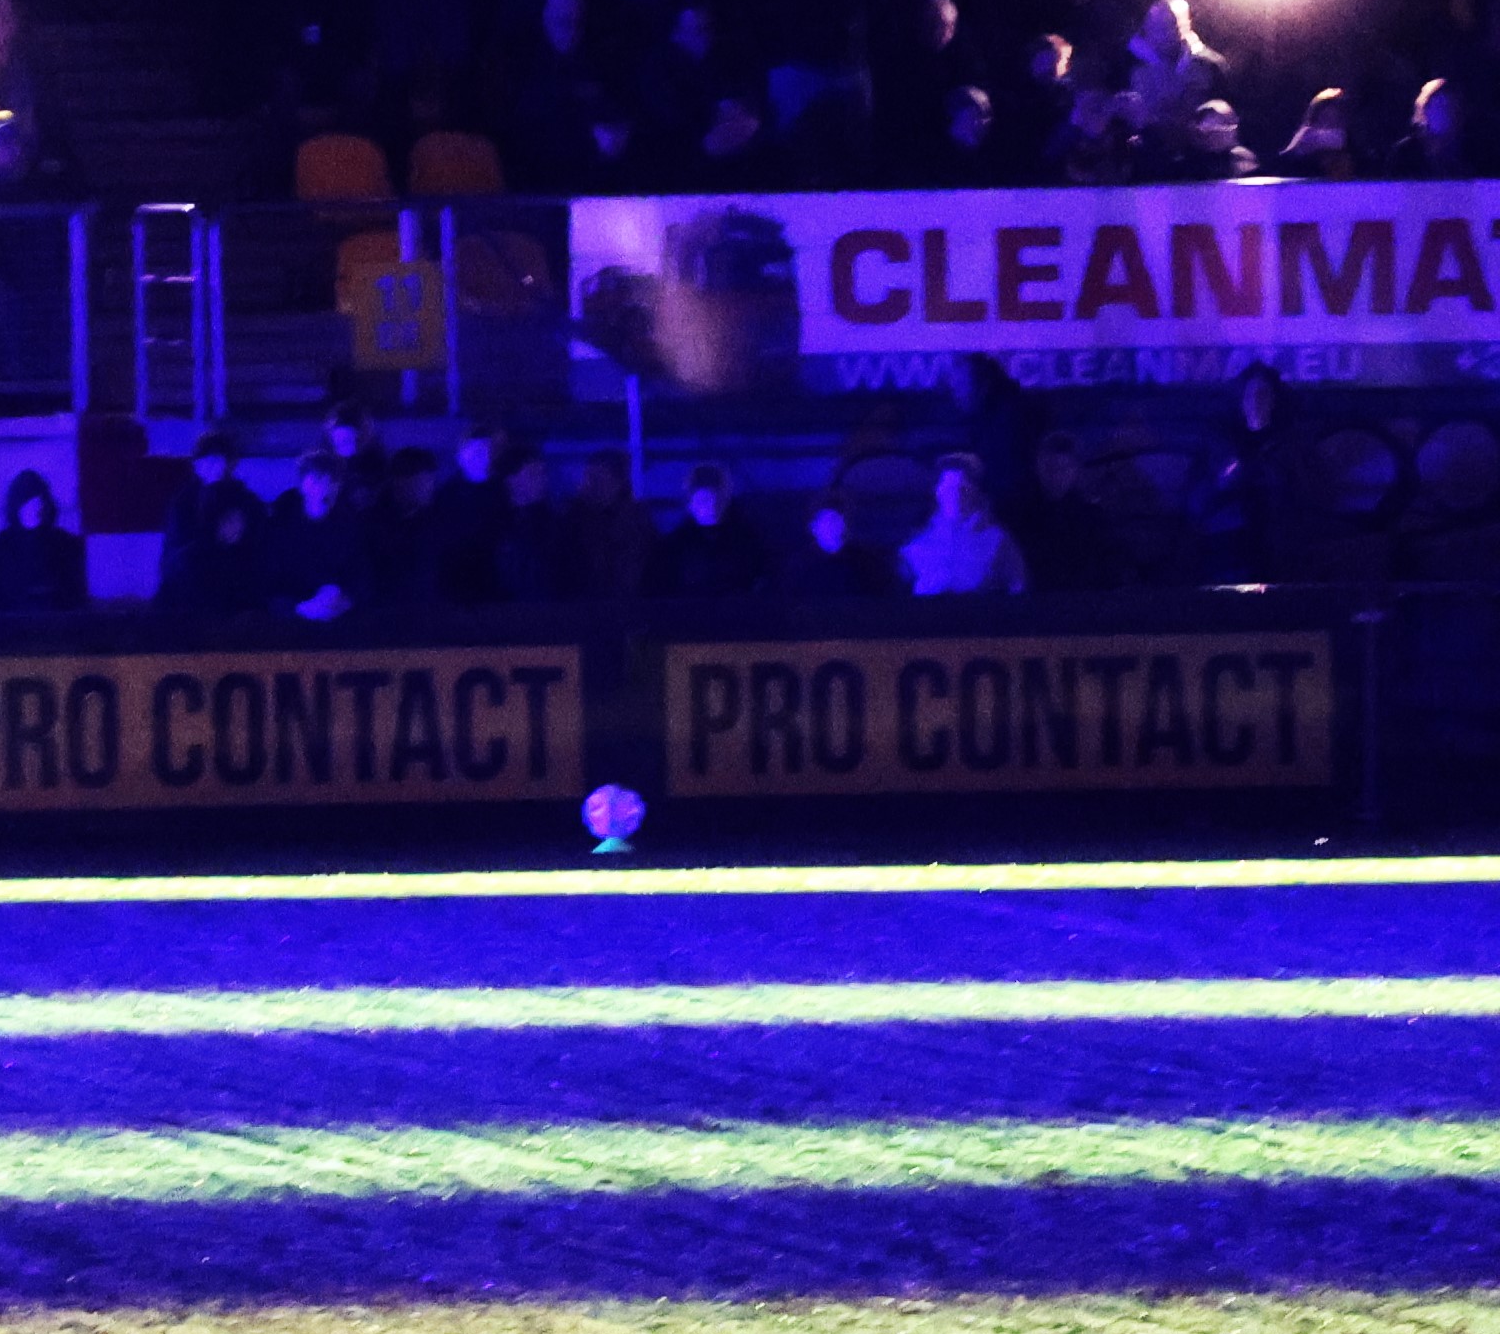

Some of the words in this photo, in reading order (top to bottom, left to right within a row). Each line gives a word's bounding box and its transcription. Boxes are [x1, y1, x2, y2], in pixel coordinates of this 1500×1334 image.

[828, 217, 1500, 325] CLEANMA
[151, 666, 564, 788] CONTACT
[695, 659, 865, 779] PRO
[899, 651, 1315, 773] CONTACT
